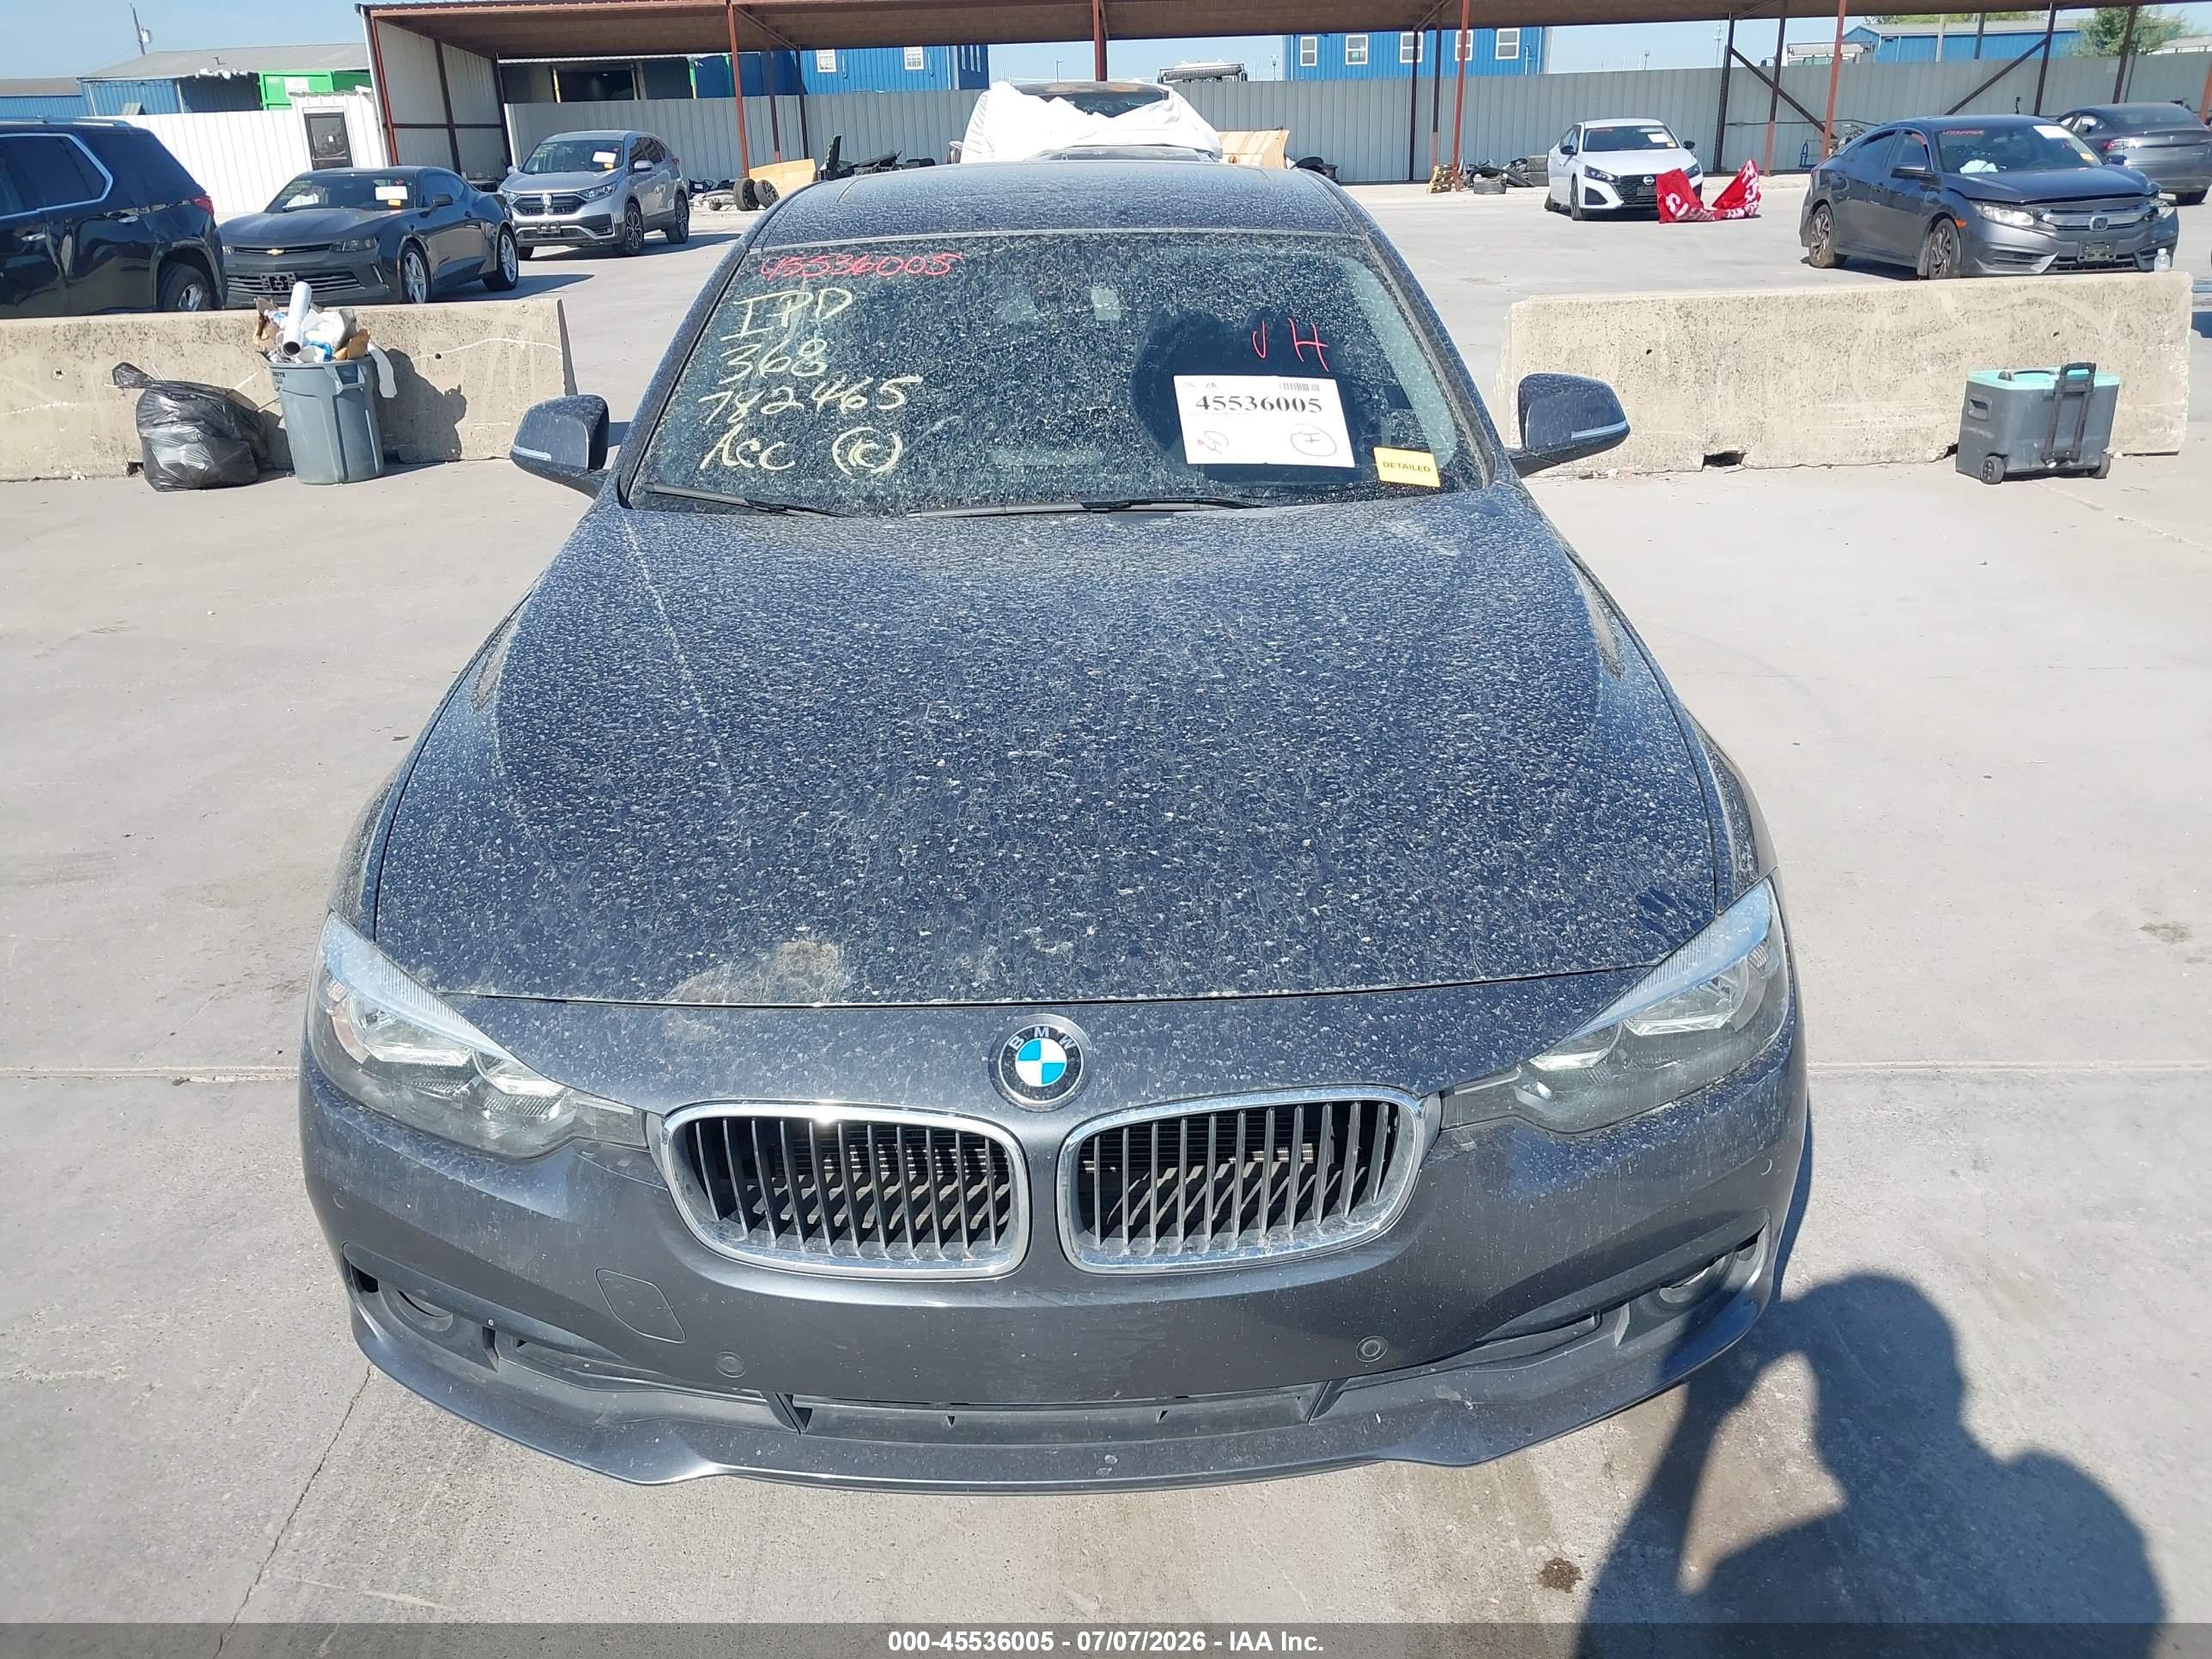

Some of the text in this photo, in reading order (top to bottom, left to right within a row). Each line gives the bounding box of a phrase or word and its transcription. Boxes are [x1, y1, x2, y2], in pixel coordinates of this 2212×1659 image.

[760, 252, 962, 281] 45536005
[1287, 317, 1330, 373] H
[718, 339, 828, 385] 368
[1195, 395, 1322, 414] 45536005
[1382, 461, 1431, 472] DETAILED
[1008, 1026, 1076, 1050] BMW
